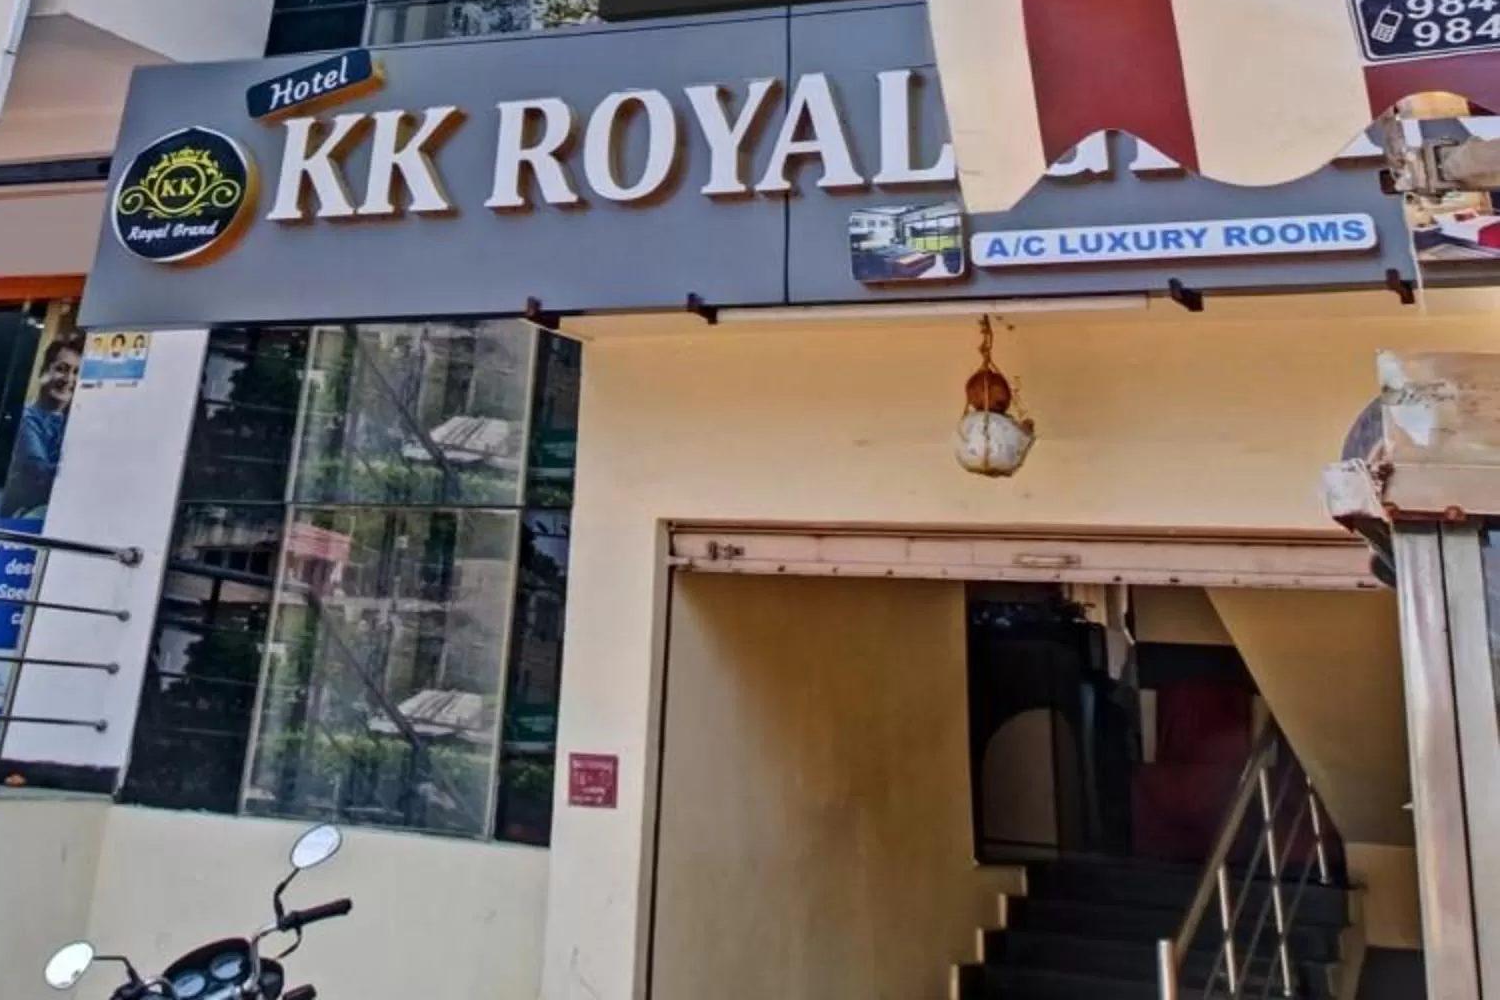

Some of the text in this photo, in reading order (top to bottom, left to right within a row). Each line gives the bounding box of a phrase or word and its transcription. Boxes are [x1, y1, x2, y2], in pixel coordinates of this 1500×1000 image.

[1412, 13, 1500, 47] 984
[268, 56, 349, 110] Hotel
[266, 105, 457, 221] KK
[484, 69, 956, 208] ROYAL
[160, 177, 197, 198] KK
[127, 219, 220, 243] Royal Grand
[985, 218, 1367, 259] A/C LUXURY ROOMS
